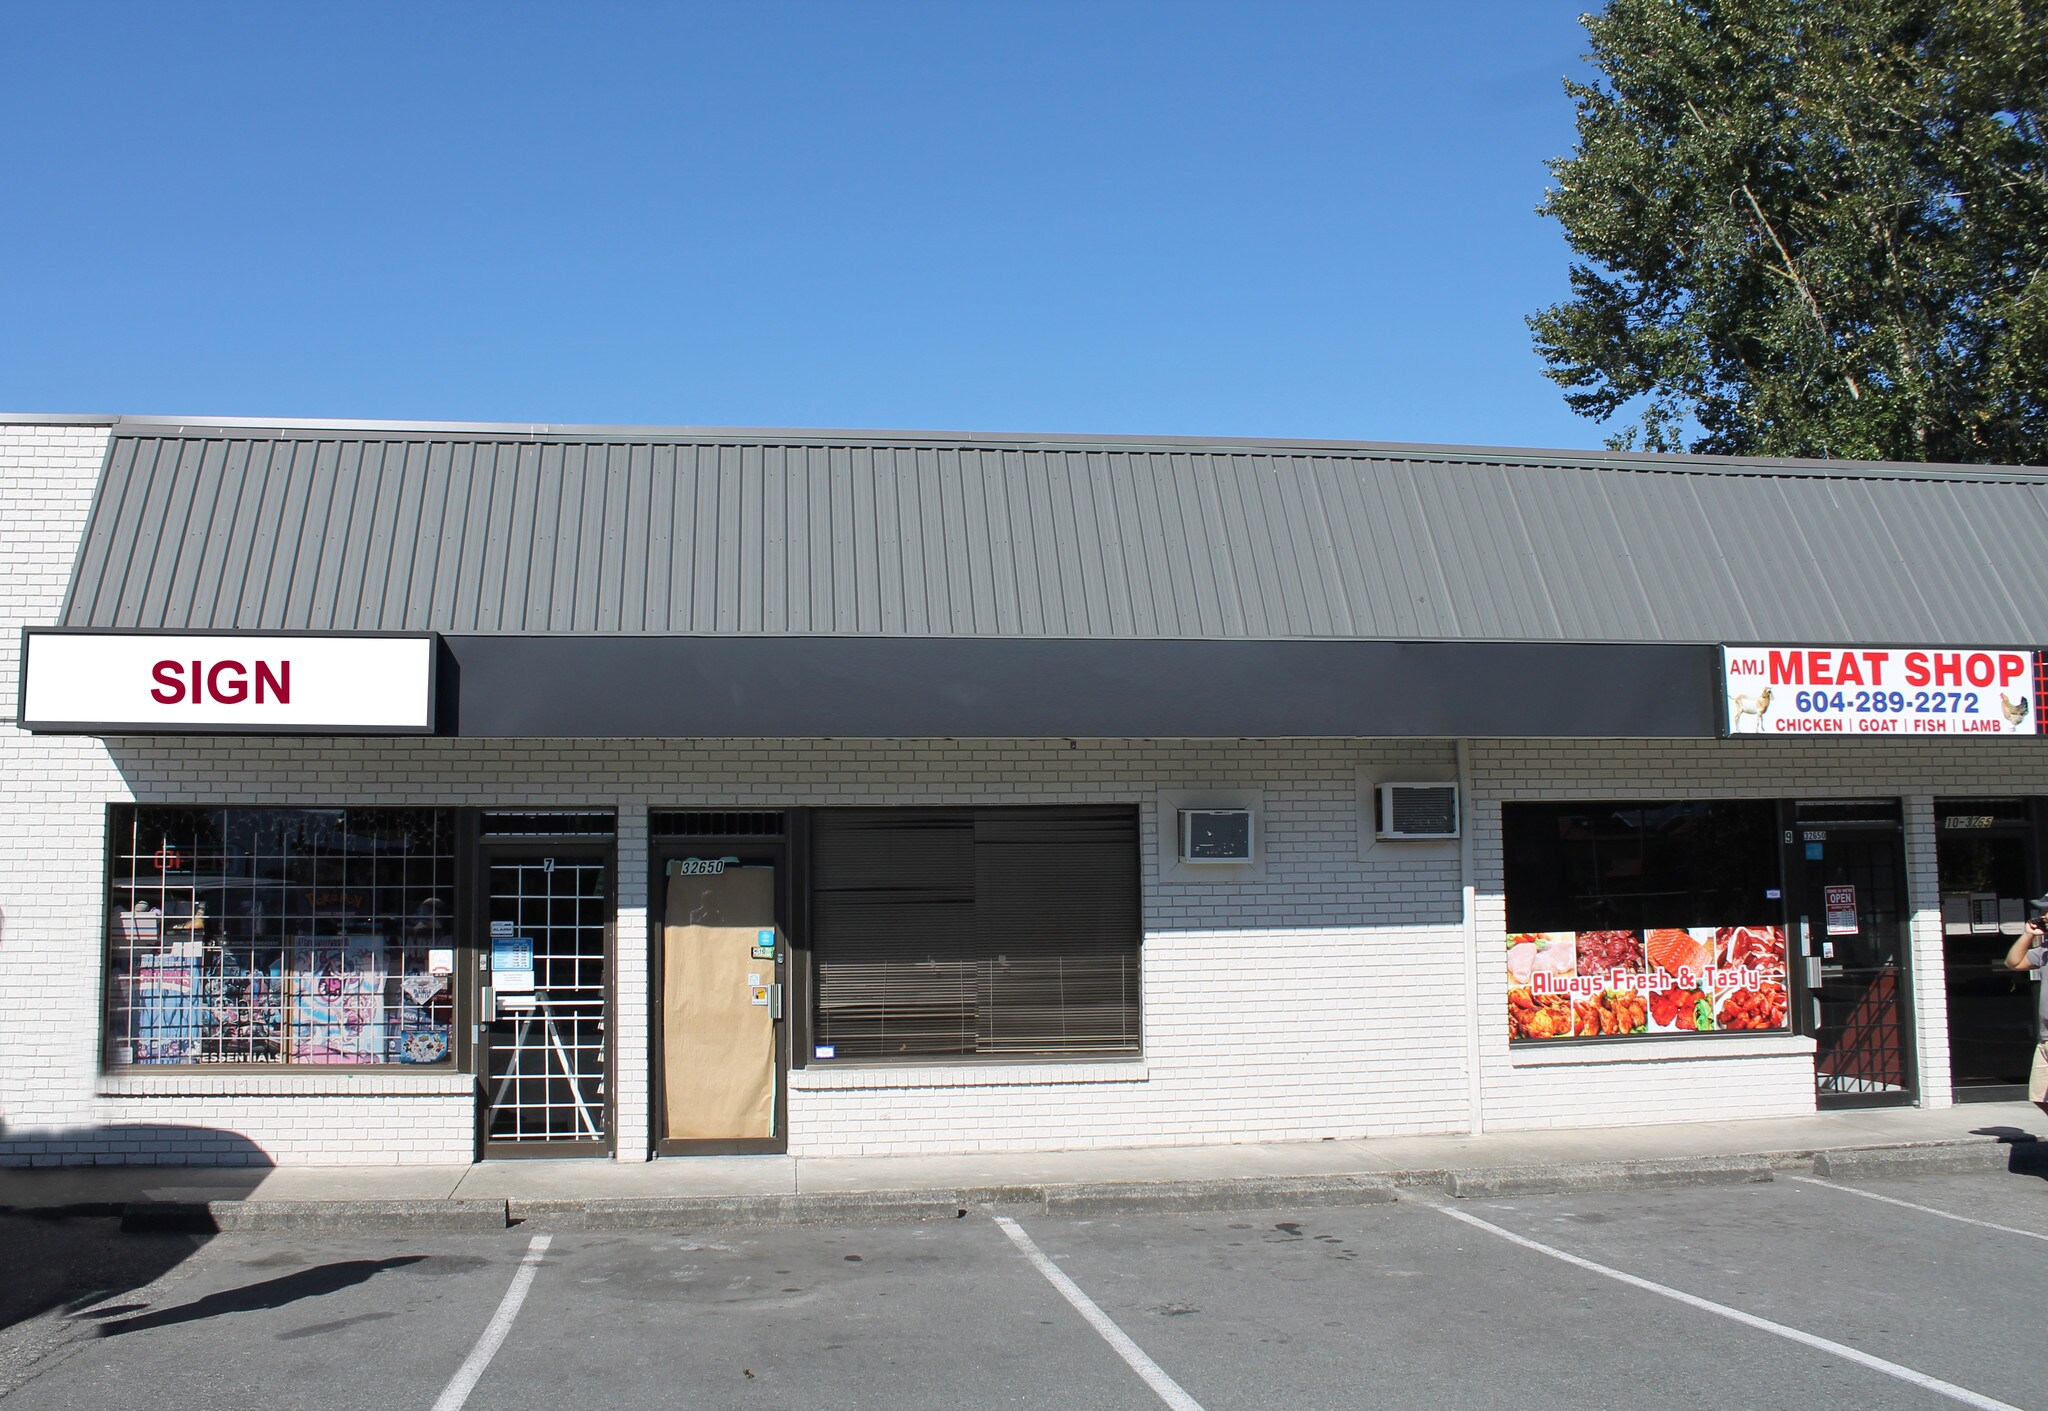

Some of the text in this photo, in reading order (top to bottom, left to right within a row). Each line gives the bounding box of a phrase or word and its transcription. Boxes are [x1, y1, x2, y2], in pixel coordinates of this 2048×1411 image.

[1729, 651, 2025, 688] AMJ MEAT SHOP
[150, 659, 291, 705] SIGN
[1795, 690, 1980, 714] 604-289-2272
[1775, 718, 2002, 733] CHICKEN GOAT FISH LAMB
[1785, 831, 1792, 843] 9
[1804, 831, 1826, 840] 32650
[545, 859, 553, 871] 7
[681, 860, 724, 875] 32650
[1830, 893, 1852, 904] OPEN
[1532, 966, 1761, 995] Always Fresh & Tasty
[201, 1052, 282, 1062] ESSENTIALS
